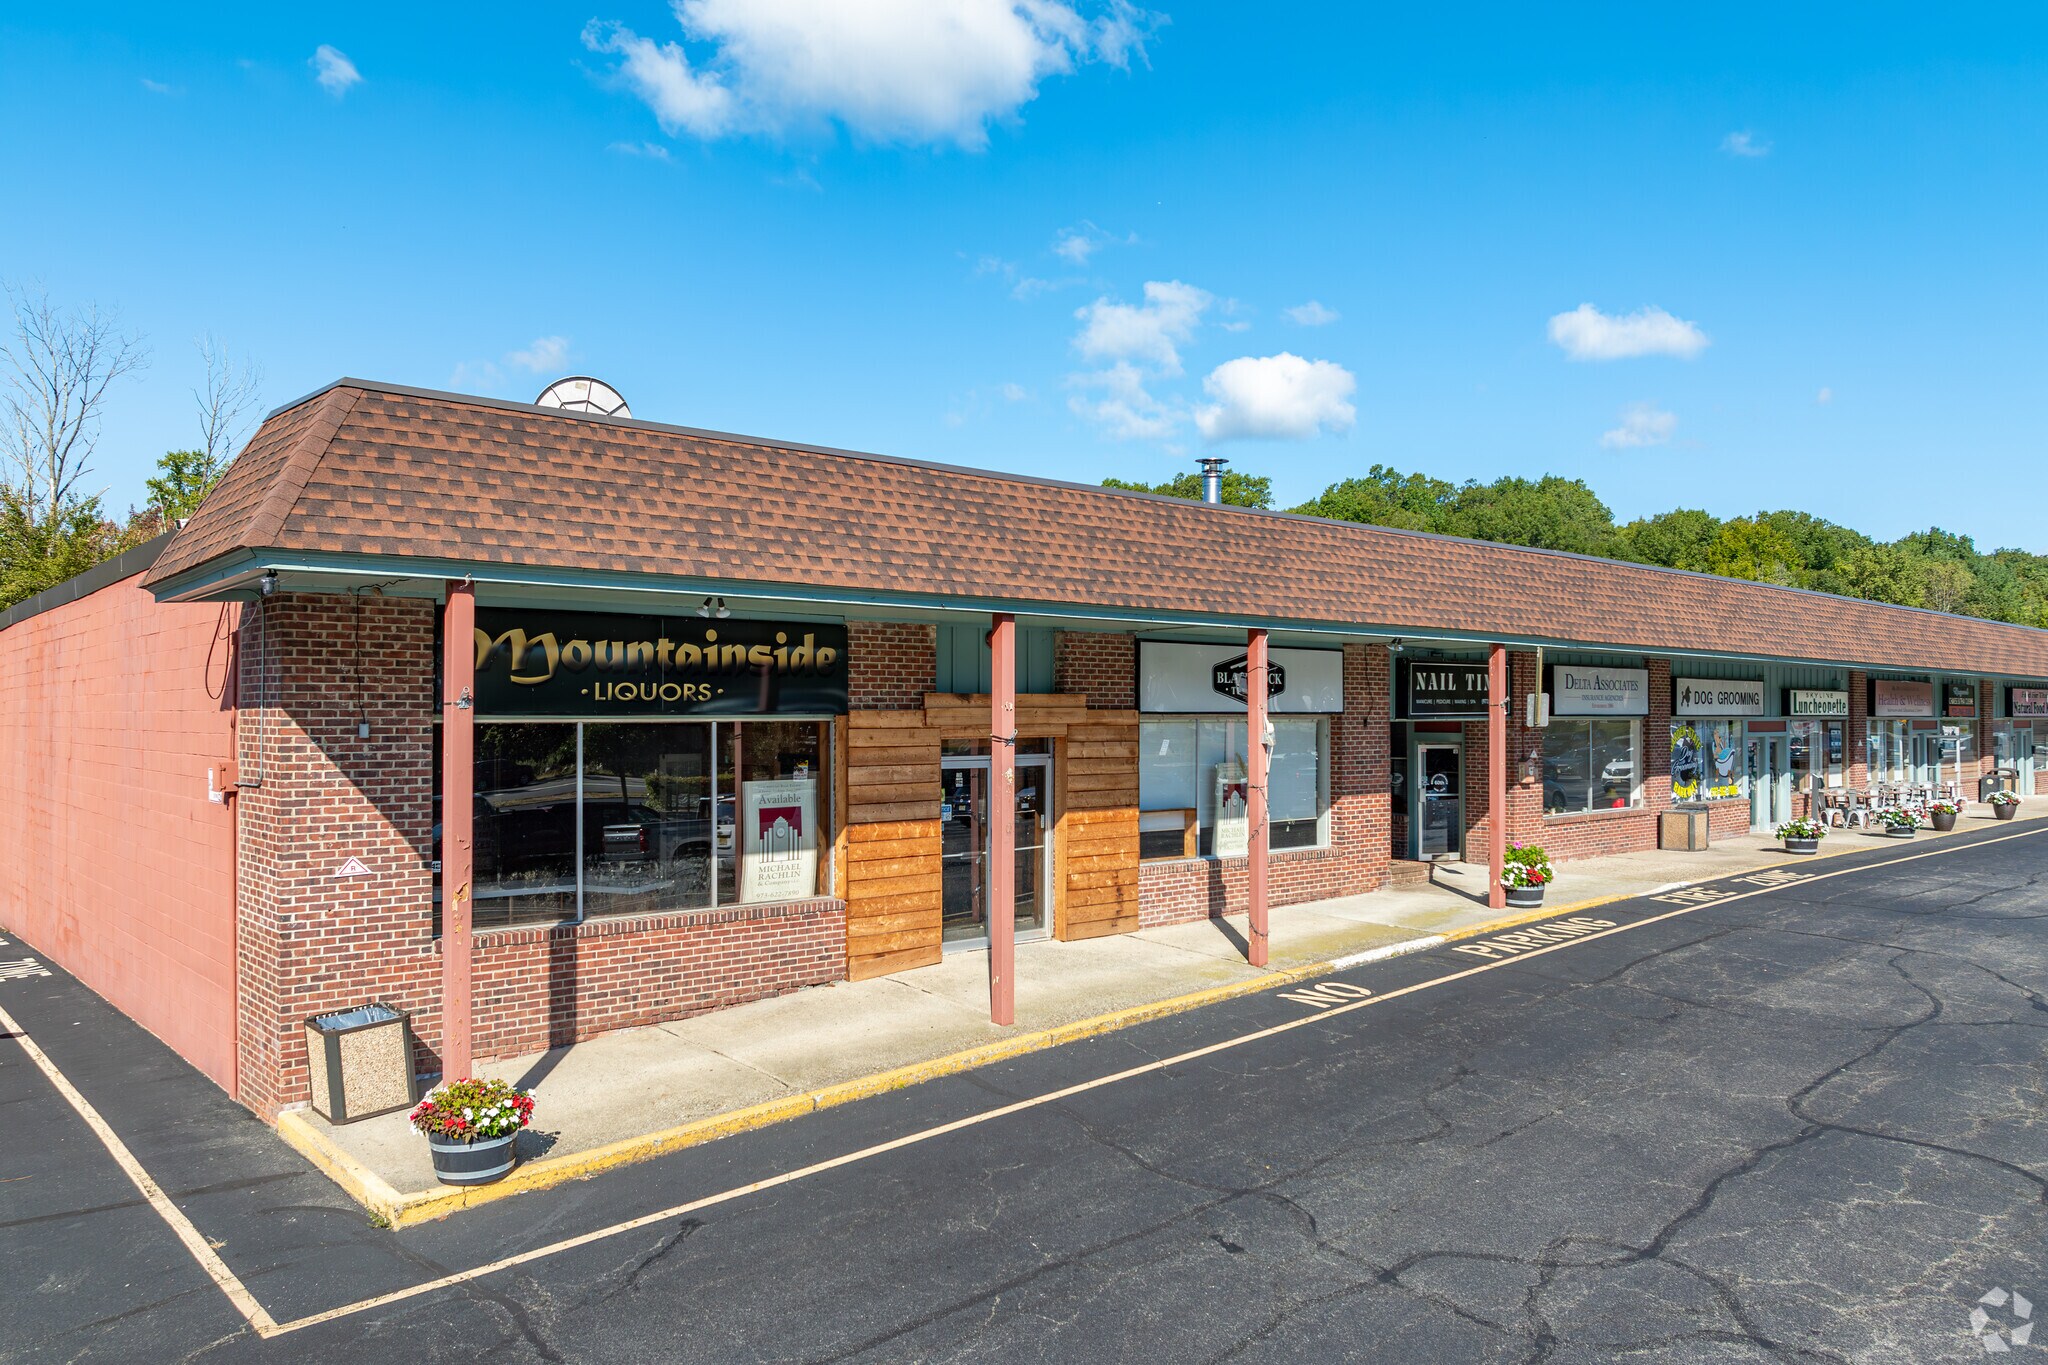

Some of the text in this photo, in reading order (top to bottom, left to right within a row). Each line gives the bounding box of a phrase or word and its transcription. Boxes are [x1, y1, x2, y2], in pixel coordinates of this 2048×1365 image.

[474, 628, 837, 685] Mountainside
[1416, 672, 1457, 691] NAIL
[594, 682, 712, 702] LIQUORS
[1694, 691, 1760, 706] DOG GROOMING
[1793, 692, 1846, 714] Luncheonette
[1878, 693, 1898, 706] Health
[2014, 701, 2033, 714] Natural
[2034, 701, 2045, 714] Food
[759, 795, 802, 805] Available
[758, 864, 801, 873] MICHAEL
[758, 871, 801, 881] RACHLIN
[756, 890, 800, 898] 973-622-7890
[1276, 869, 1816, 1009] NO PARKING FIRE ZONE
